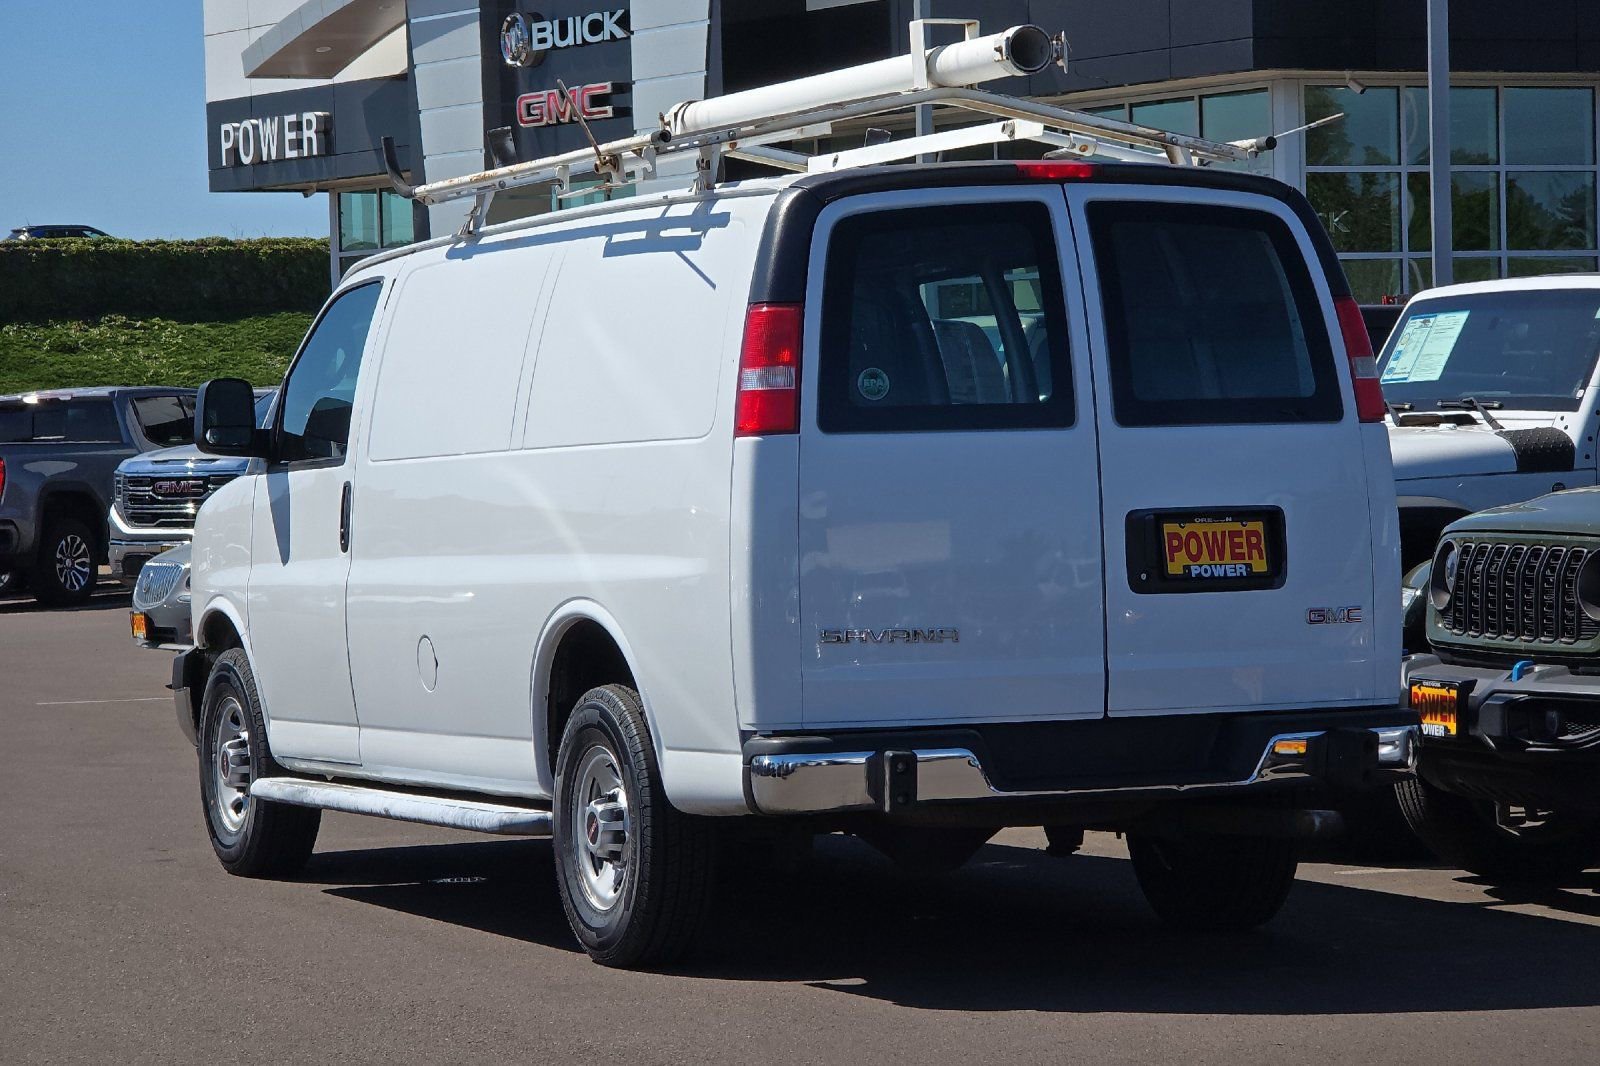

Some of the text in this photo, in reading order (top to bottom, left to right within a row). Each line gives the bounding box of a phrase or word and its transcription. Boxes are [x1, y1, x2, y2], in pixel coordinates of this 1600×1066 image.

[531, 9, 627, 51] BUICK
[516, 81, 613, 128] GMC
[220, 111, 326, 167] POWER
[154, 480, 203, 494] GMC
[1166, 530, 1264, 562] POWER
[1191, 564, 1247, 578] POWER
[1306, 607, 1362, 624] GMC
[820, 628, 960, 644] SAVANA
[1421, 723, 1445, 737] OWER
